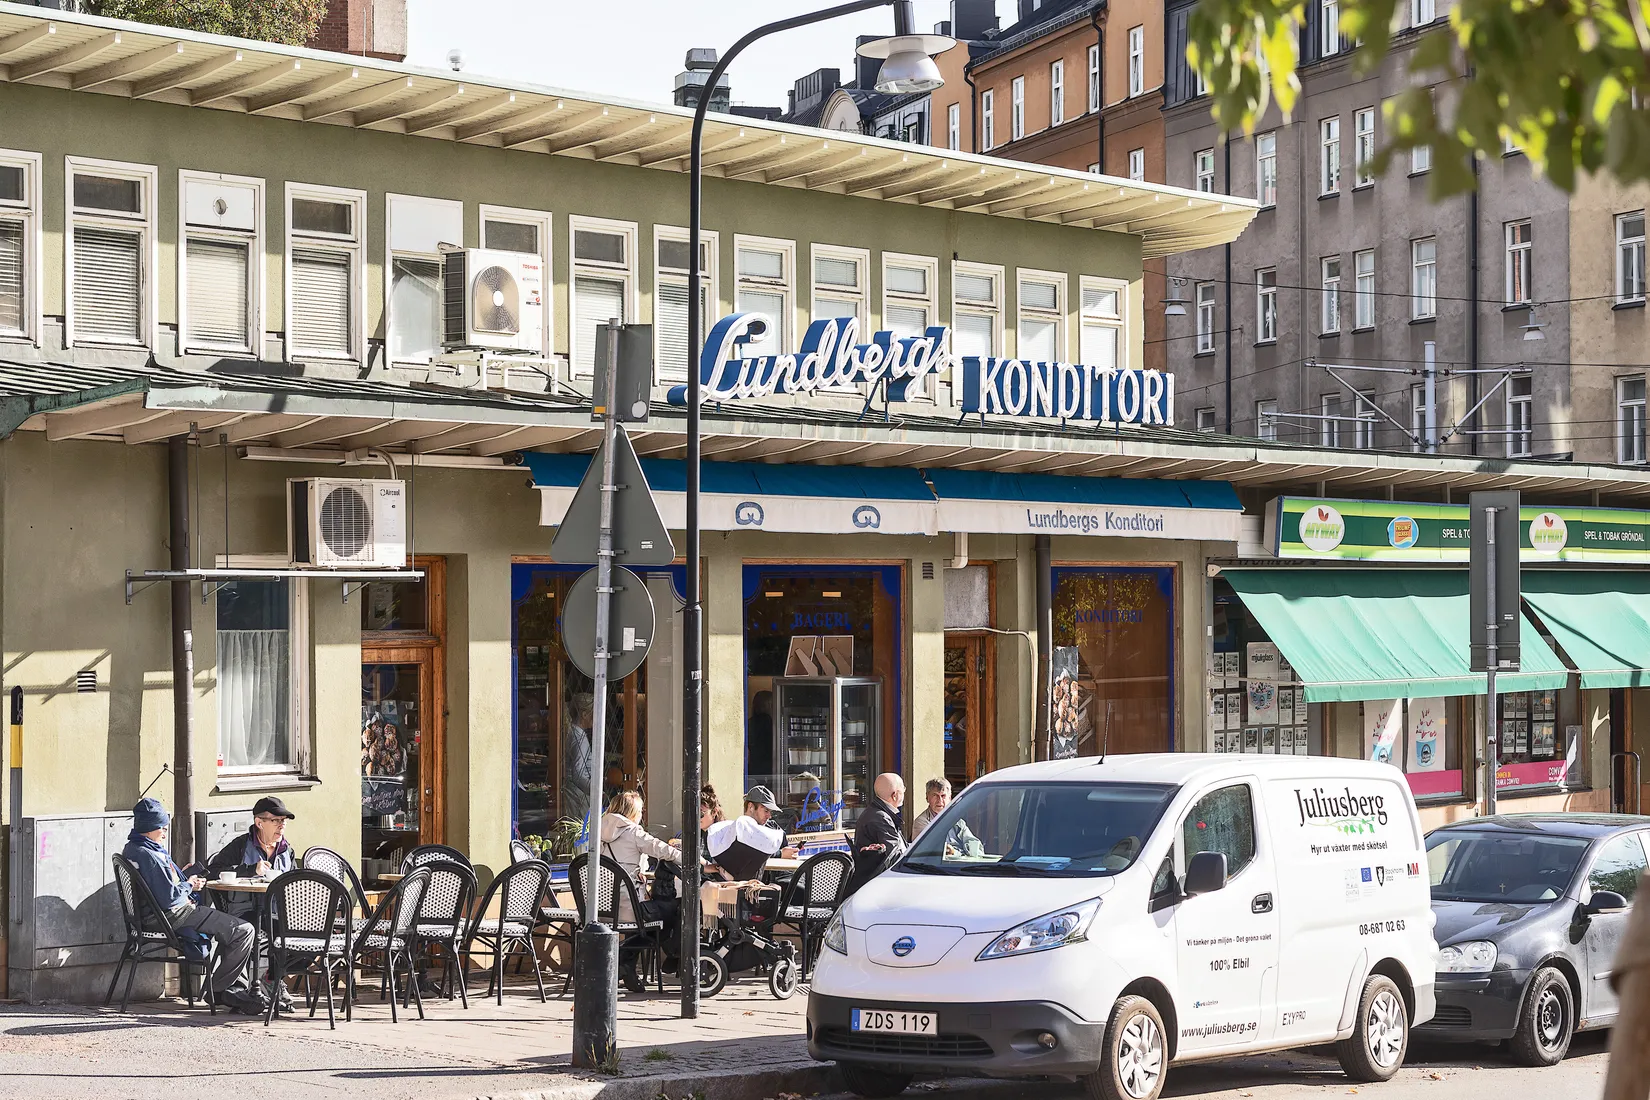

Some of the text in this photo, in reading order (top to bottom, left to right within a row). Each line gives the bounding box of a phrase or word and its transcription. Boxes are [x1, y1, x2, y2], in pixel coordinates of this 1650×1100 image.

[667, 312, 1175, 426] Lundbergs KONDITORI
[1026, 508, 1164, 533] Lundbergs Konditori
[1442, 528, 1458, 539] SPEL
[1458, 529, 1463, 539] &
[1584, 530, 1598, 540] SPEL
[1603, 531, 1620, 541] TOBAK
[1621, 530, 1645, 542] GRÖNDAL
[794, 611, 850, 628] BAGERI
[1075, 609, 1143, 623] KONDITORI
[1293, 787, 1388, 828] Juliusberg
[1310, 840, 1388, 855] Hyr ut växter med skötsel
[1359, 919, 1406, 935] 08-687 02 63
[1236, 935, 1245, 943] Det
[1209, 957, 1250, 971] 100% Elbil
[865, 1012, 930, 1032] ZDS 119
[1181, 1020, 1257, 1038] www.juliusberg.se
